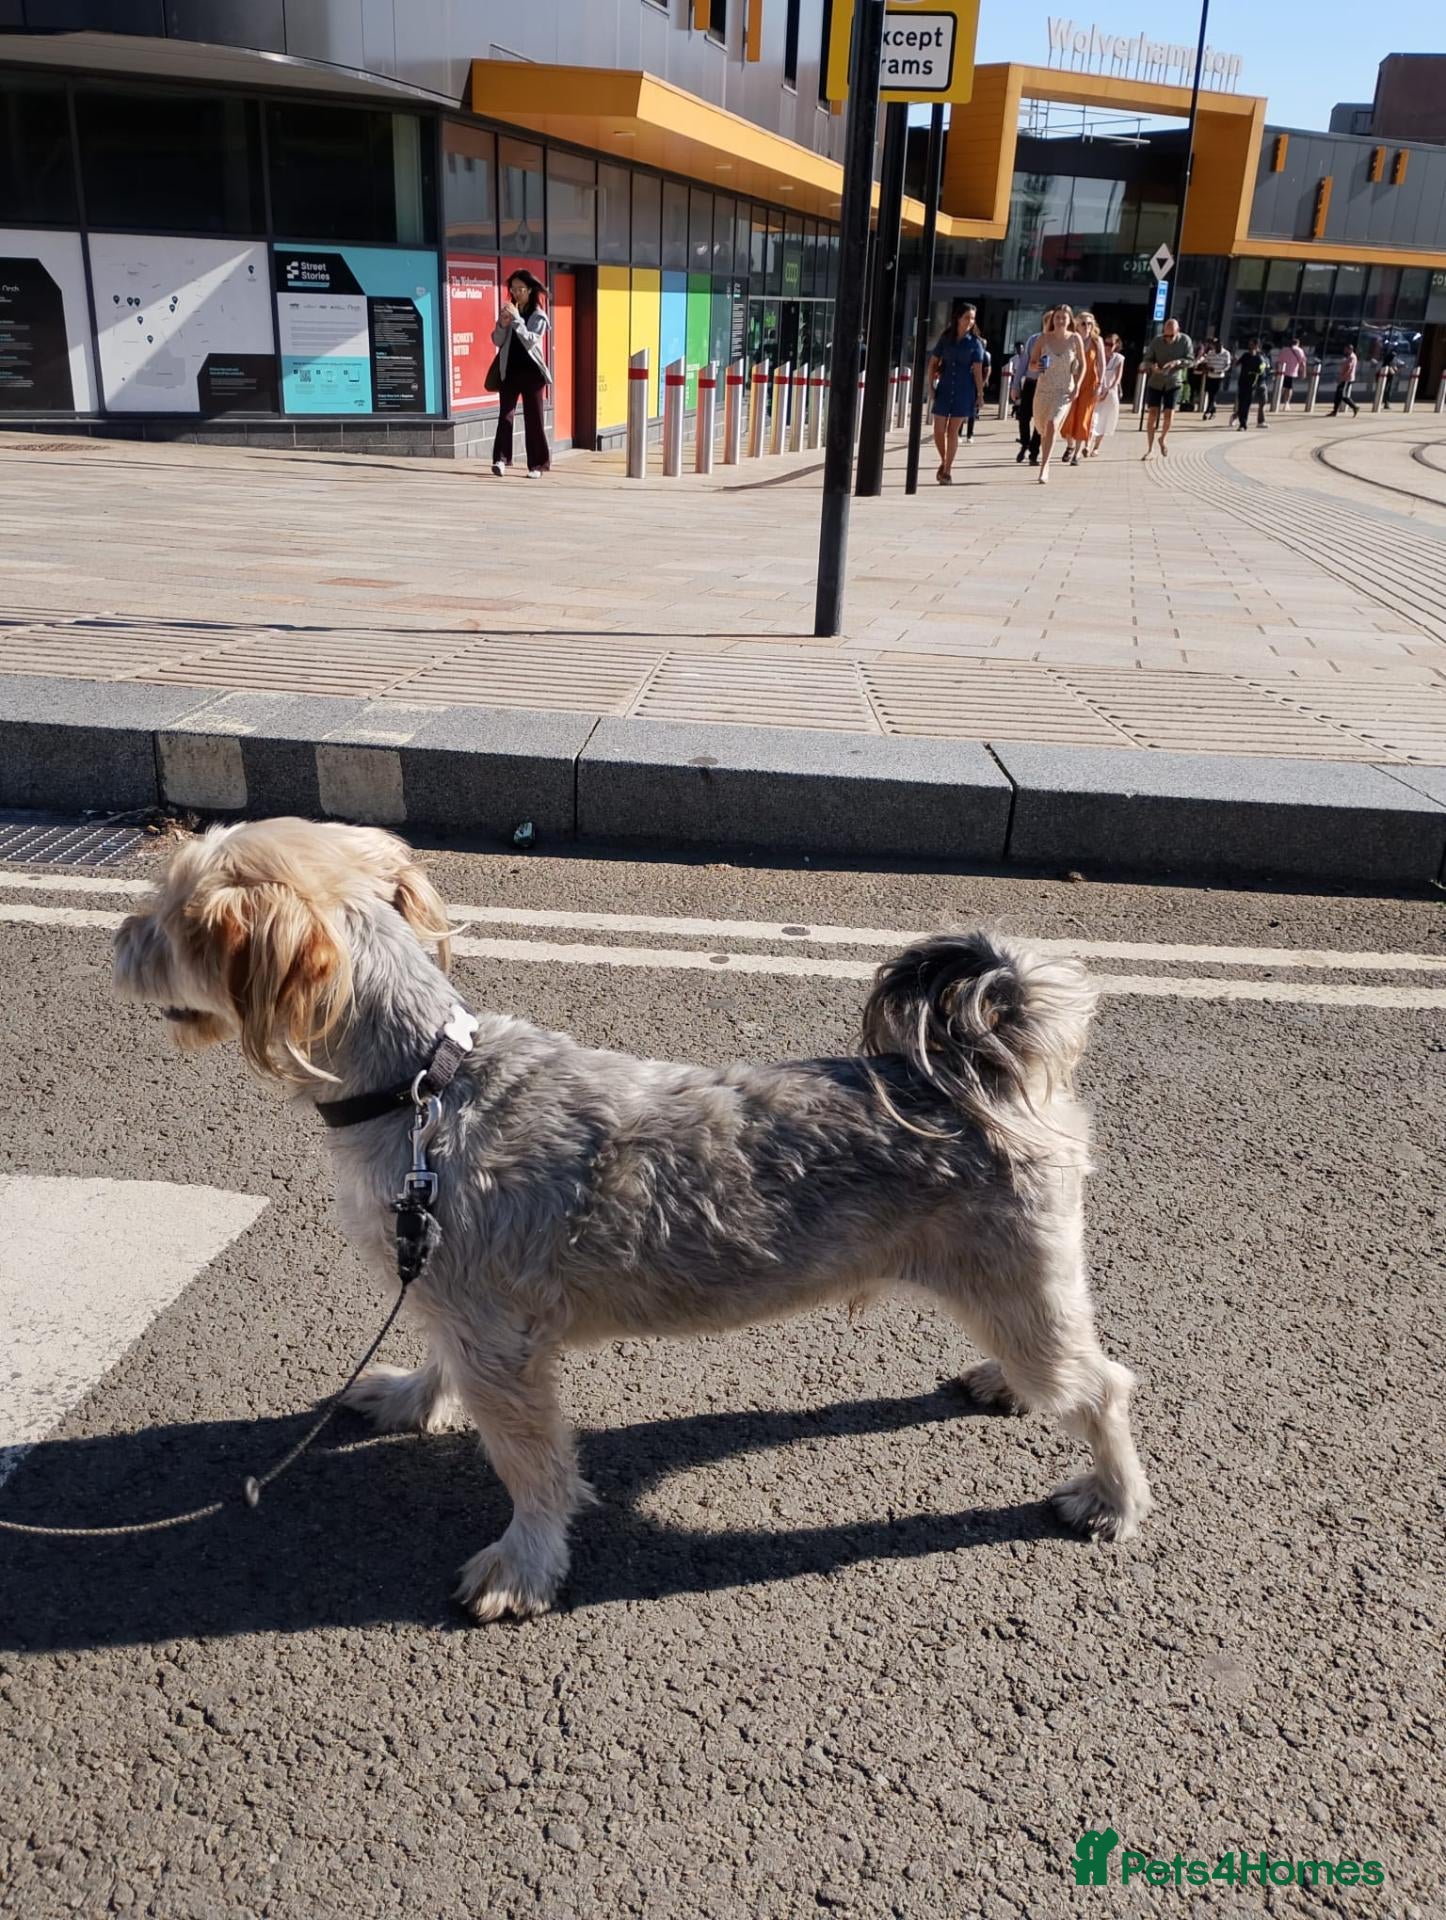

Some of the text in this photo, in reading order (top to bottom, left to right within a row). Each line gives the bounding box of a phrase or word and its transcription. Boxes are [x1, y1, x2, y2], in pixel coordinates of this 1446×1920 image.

[883, 27, 943, 51] xcept
[1048, 16, 1243, 77] Wolverhampton
[881, 59, 933, 75] ams
[301, 261, 326, 271] Street
[301, 271, 330, 281] Stories
